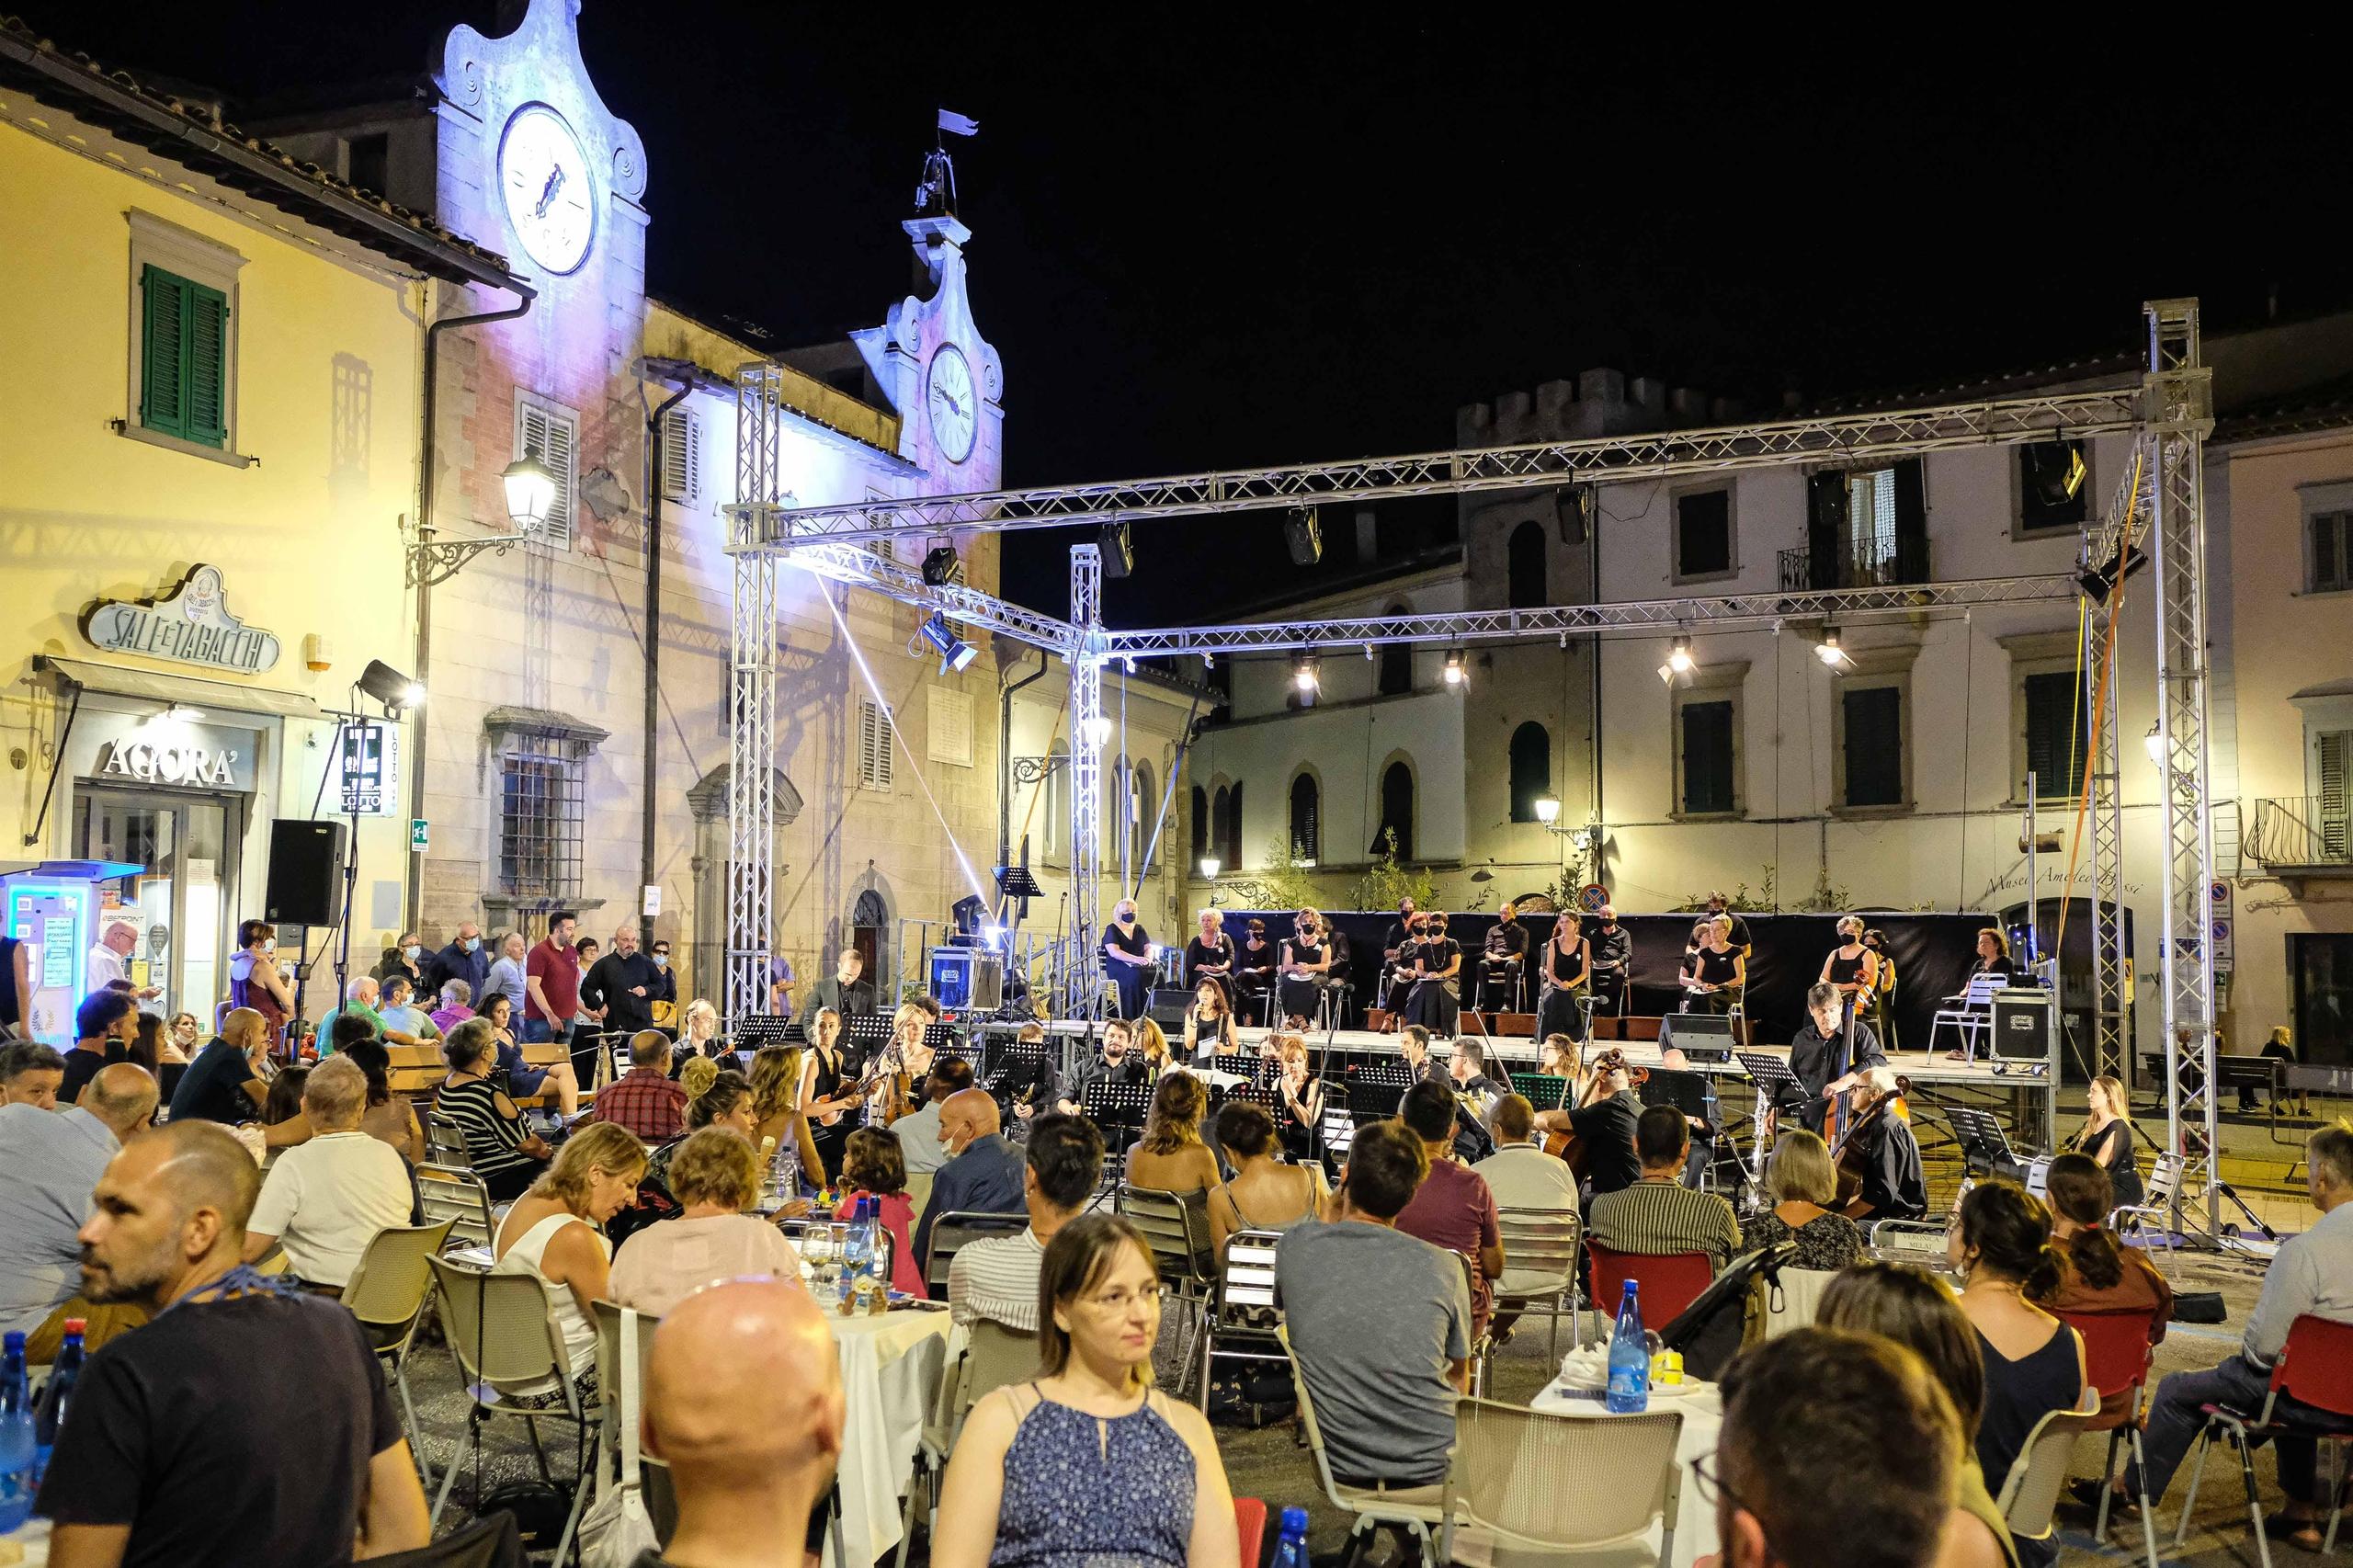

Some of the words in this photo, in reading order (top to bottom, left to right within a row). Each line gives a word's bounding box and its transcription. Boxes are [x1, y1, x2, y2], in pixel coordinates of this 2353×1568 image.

[172, 619, 266, 670] TABACCHI
[2099, 870, 2144, 894] Bssi
[1903, 1233, 1939, 1243] VERONICA
